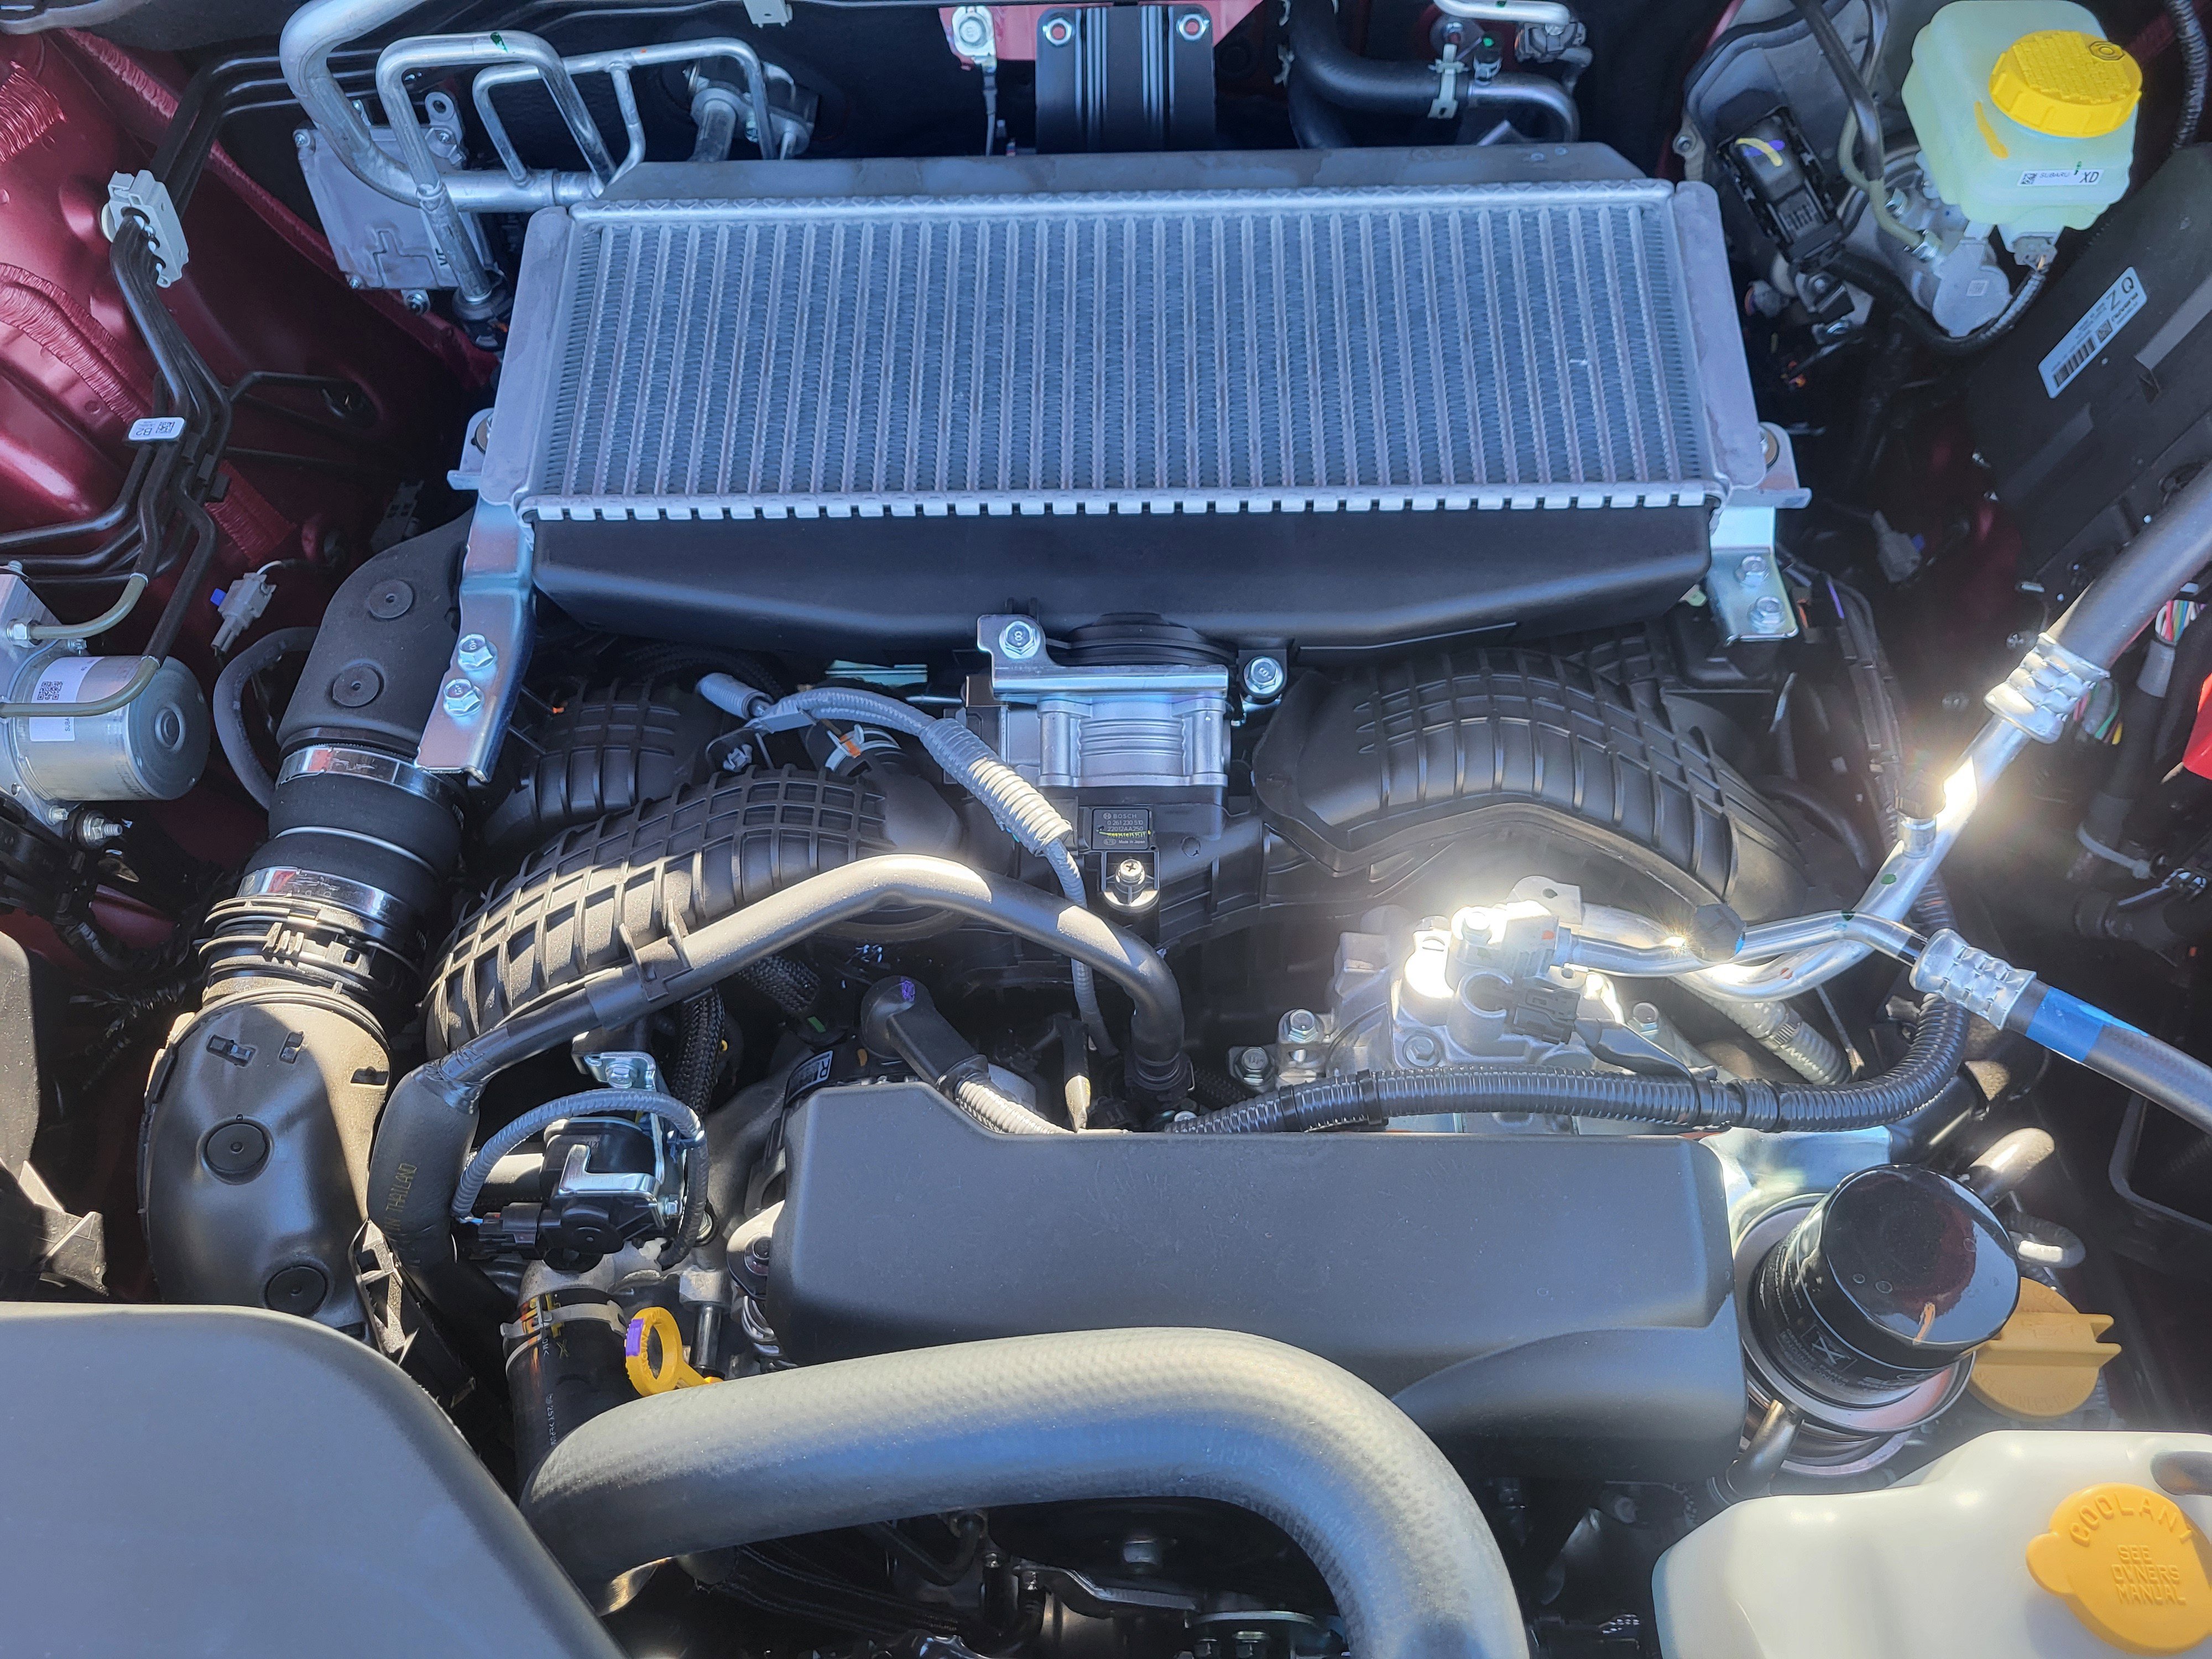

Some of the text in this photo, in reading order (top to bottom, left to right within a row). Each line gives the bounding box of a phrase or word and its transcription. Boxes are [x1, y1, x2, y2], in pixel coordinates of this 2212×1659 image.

[2079, 171, 2100, 183] XD
[135, 427, 153, 436] B2
[2069, 1492, 2195, 1548] COOLANT
[2117, 1545, 2153, 1564] SEE
[2111, 1564, 2180, 1585] OWNERS
[2115, 1583, 2187, 1606] MANUAL
